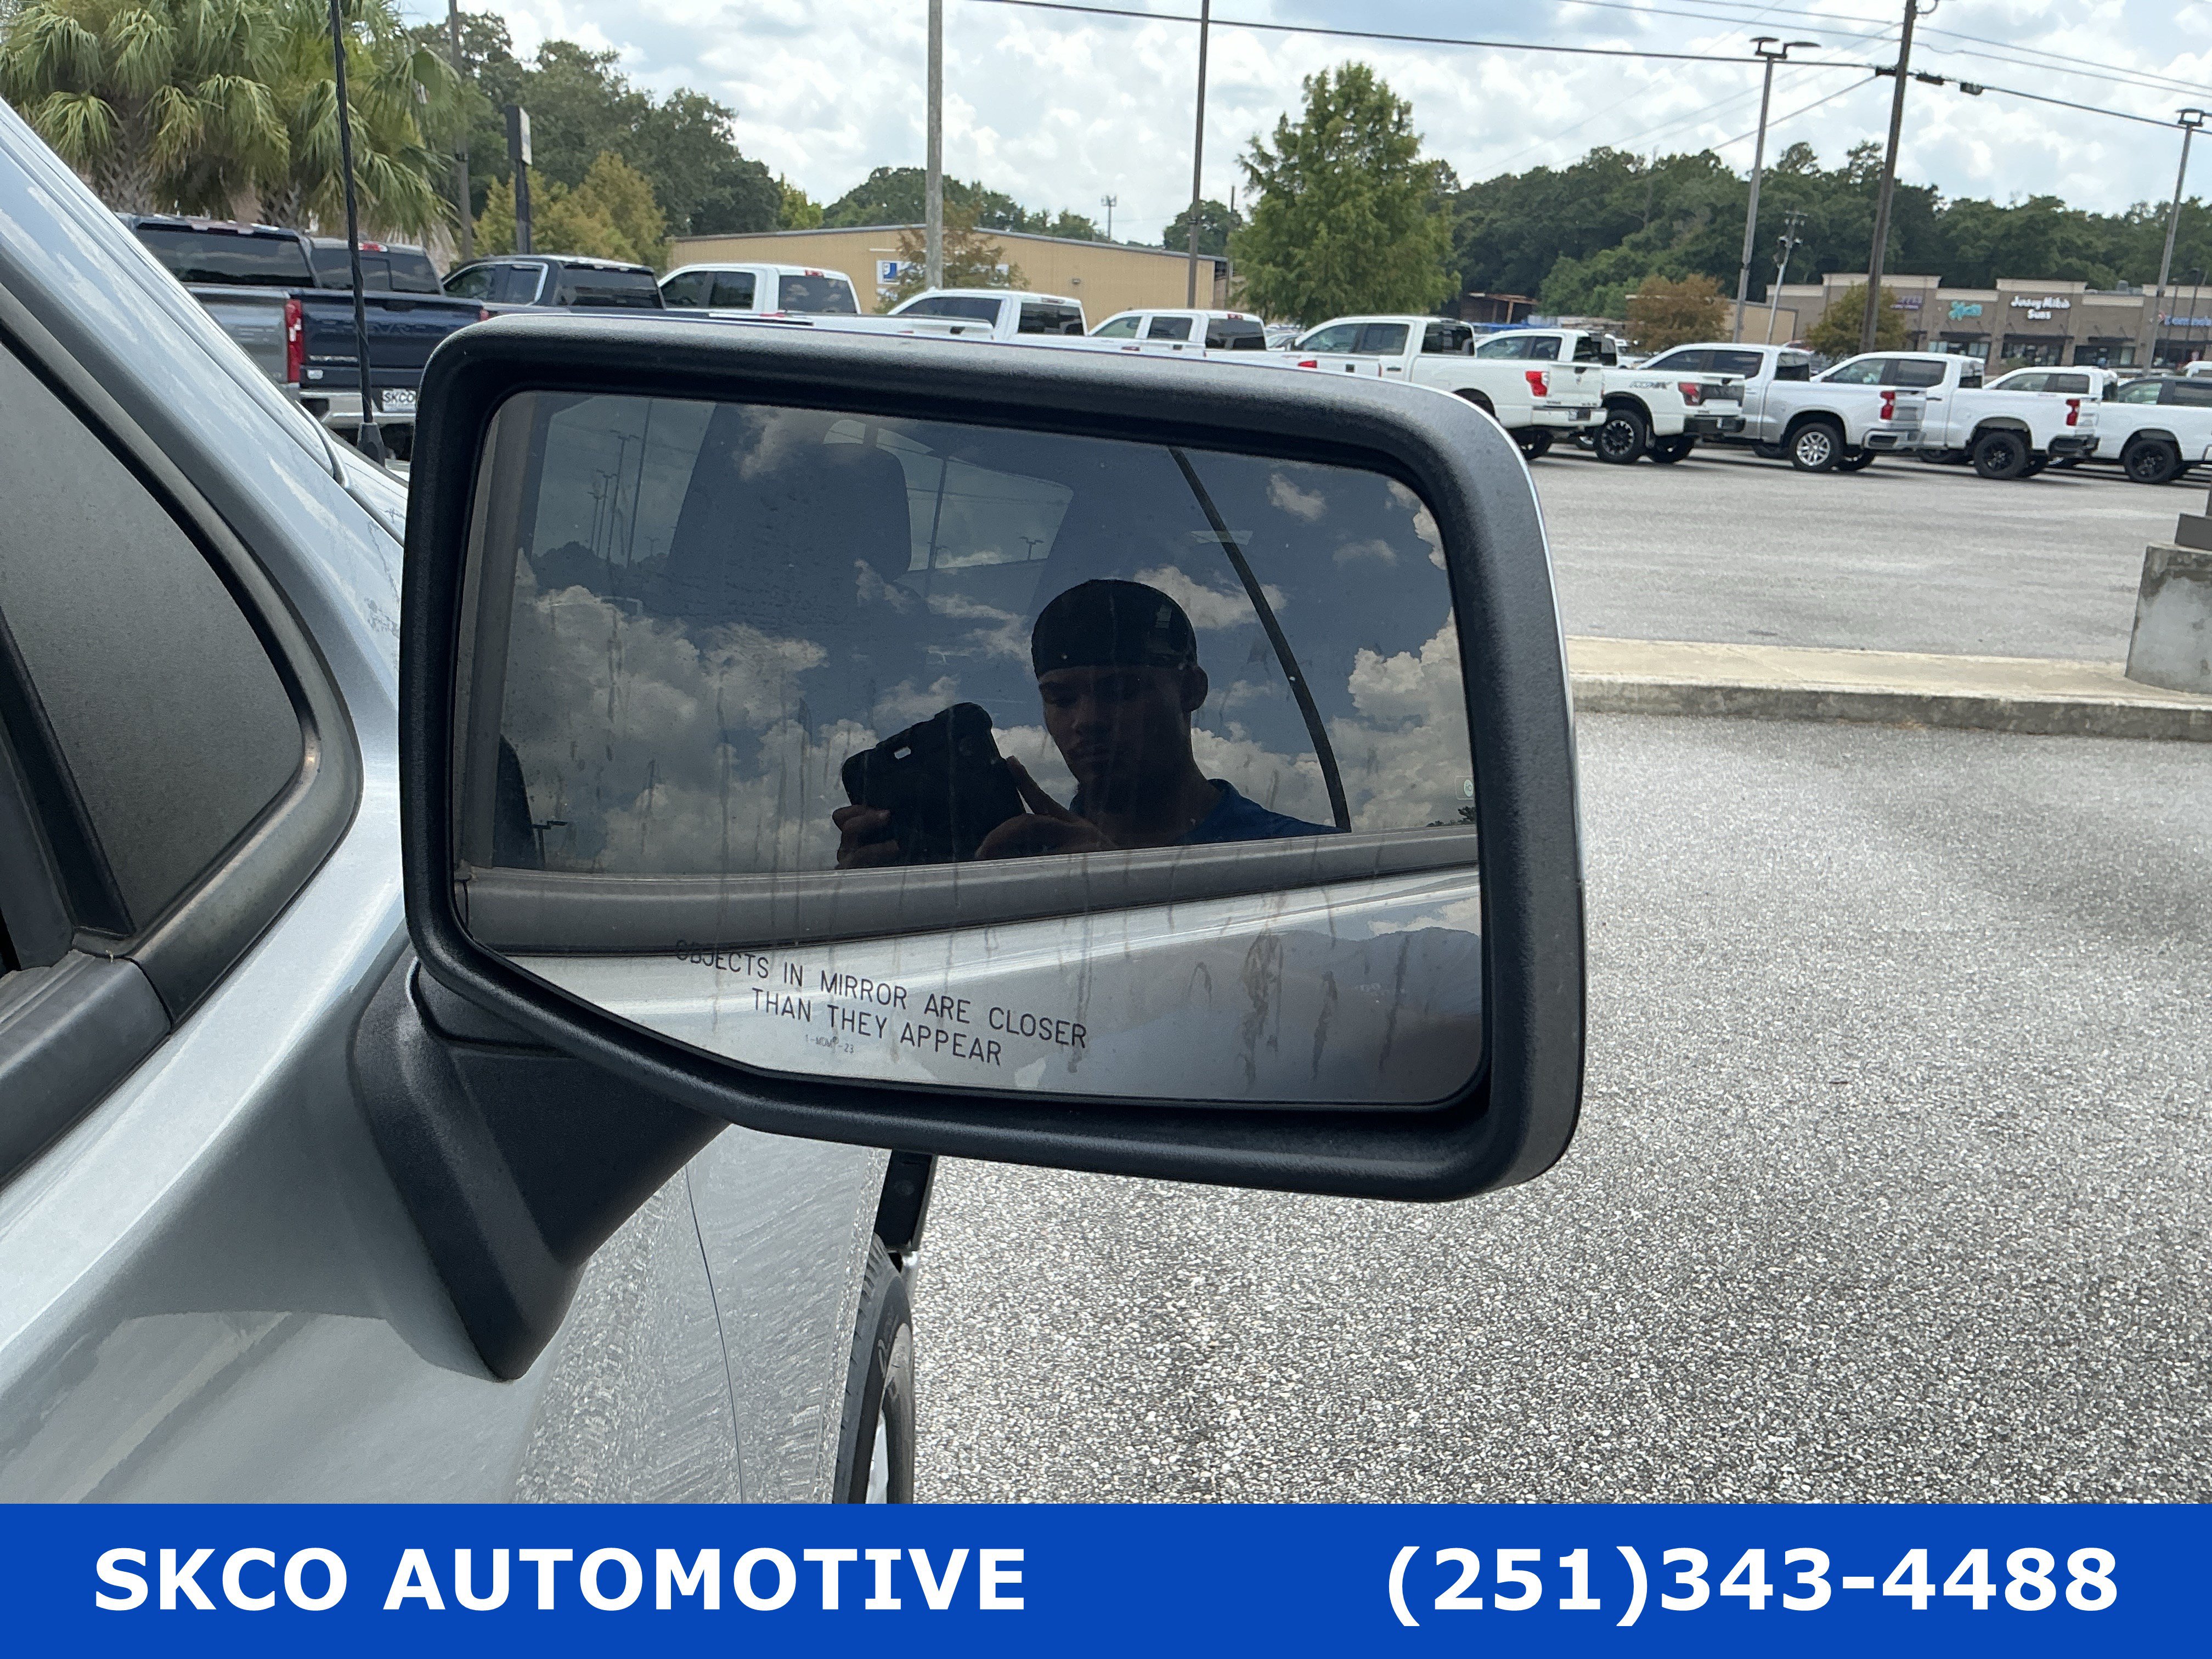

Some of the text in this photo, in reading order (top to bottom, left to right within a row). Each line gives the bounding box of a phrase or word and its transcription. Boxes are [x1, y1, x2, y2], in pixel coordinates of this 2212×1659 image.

[383, 392, 415, 403] SKCO
[676, 939, 1087, 1048] OBJECTS IN MIRROR ARE CLOSER
[752, 987, 1002, 1066] THAN THEY APPEAR
